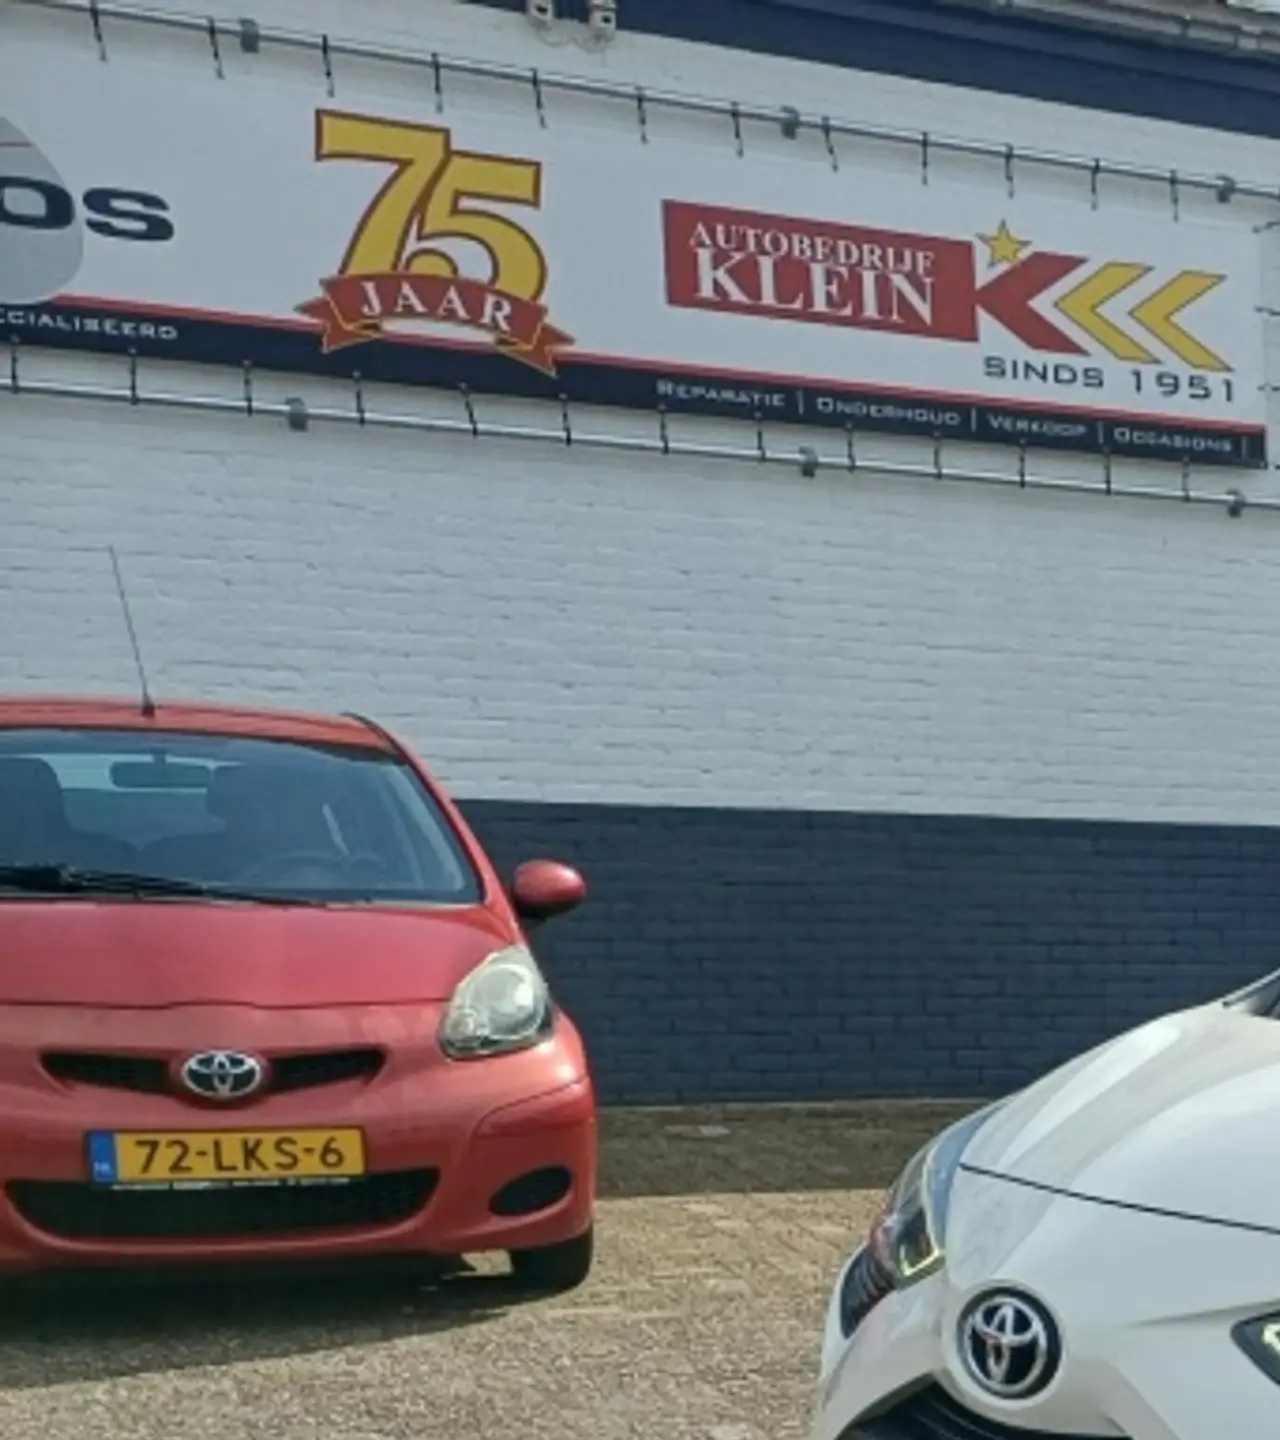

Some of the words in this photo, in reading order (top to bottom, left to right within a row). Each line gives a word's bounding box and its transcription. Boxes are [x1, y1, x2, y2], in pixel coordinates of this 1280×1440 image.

[315, 108, 548, 302] 75
[690, 221, 935, 276] AUTOBEDRIJF
[360, 280, 512, 331] JAAR
[694, 246, 935, 327] KLEIN
[984, 355, 1104, 388] SINDS
[1130, 368, 1234, 401] 1951
[135, 1136, 344, 1175] 72-LKS-6
